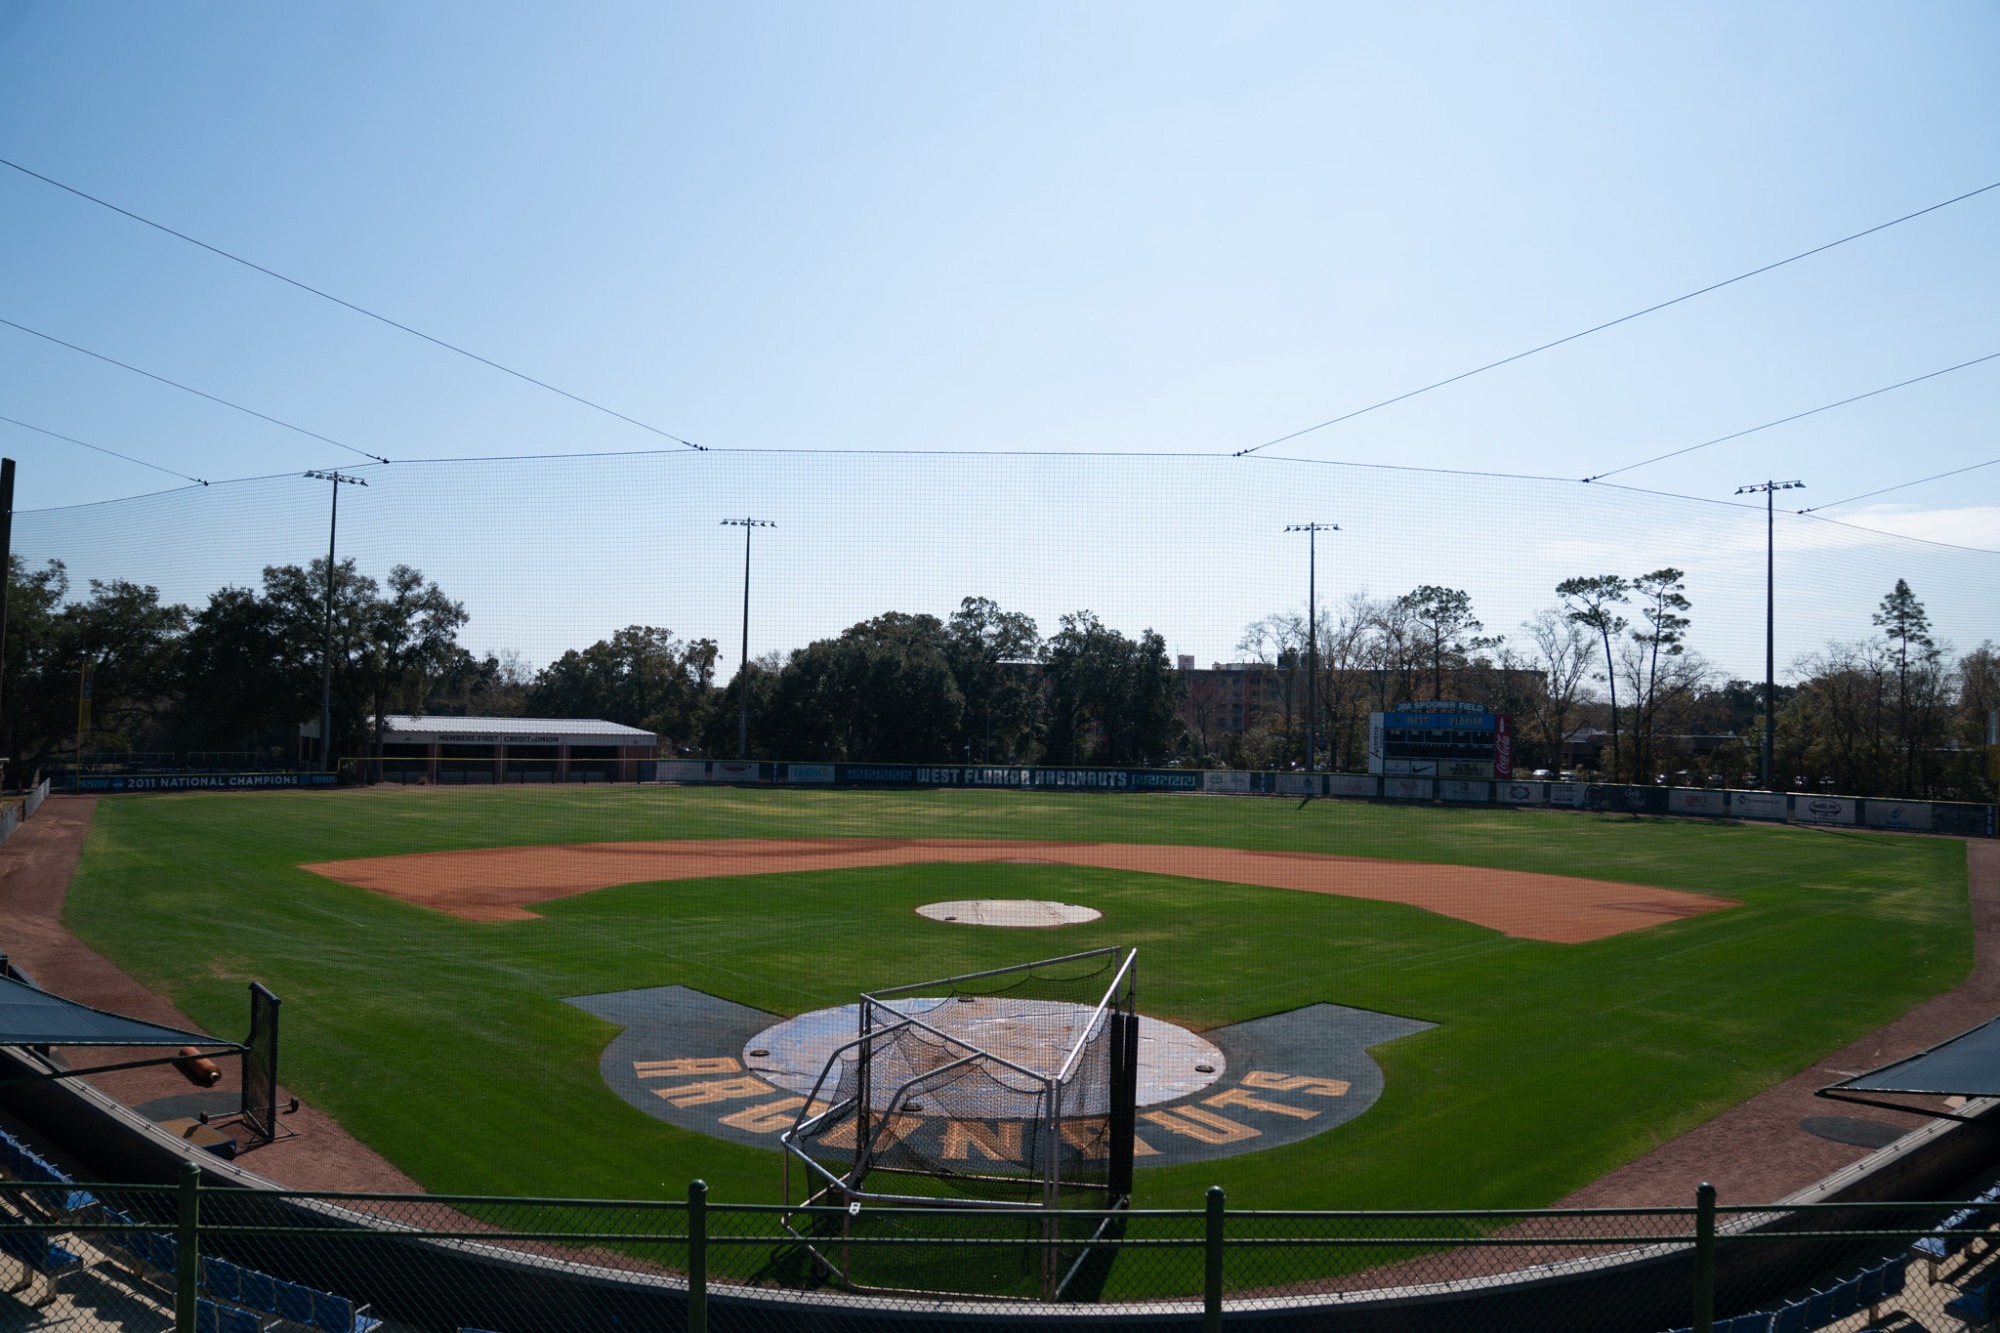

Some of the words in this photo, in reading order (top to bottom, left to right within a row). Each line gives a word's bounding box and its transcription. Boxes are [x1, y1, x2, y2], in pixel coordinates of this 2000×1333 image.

[1397, 702, 1411, 711] JIM
[1414, 701, 1456, 709] SPOONER
[1459, 702, 1484, 712] FIELD
[1407, 716, 1428, 725] WEST
[1450, 716, 1483, 726] FLORIDA
[127, 778, 155, 788] 2011
[160, 777, 225, 788] NATIONAL
[229, 775, 298, 786] CHAMPIONS
[916, 769, 960, 784] WEST
[964, 769, 1030, 785] FLORIDA
[1035, 770, 1127, 787] ARGONAUTS
